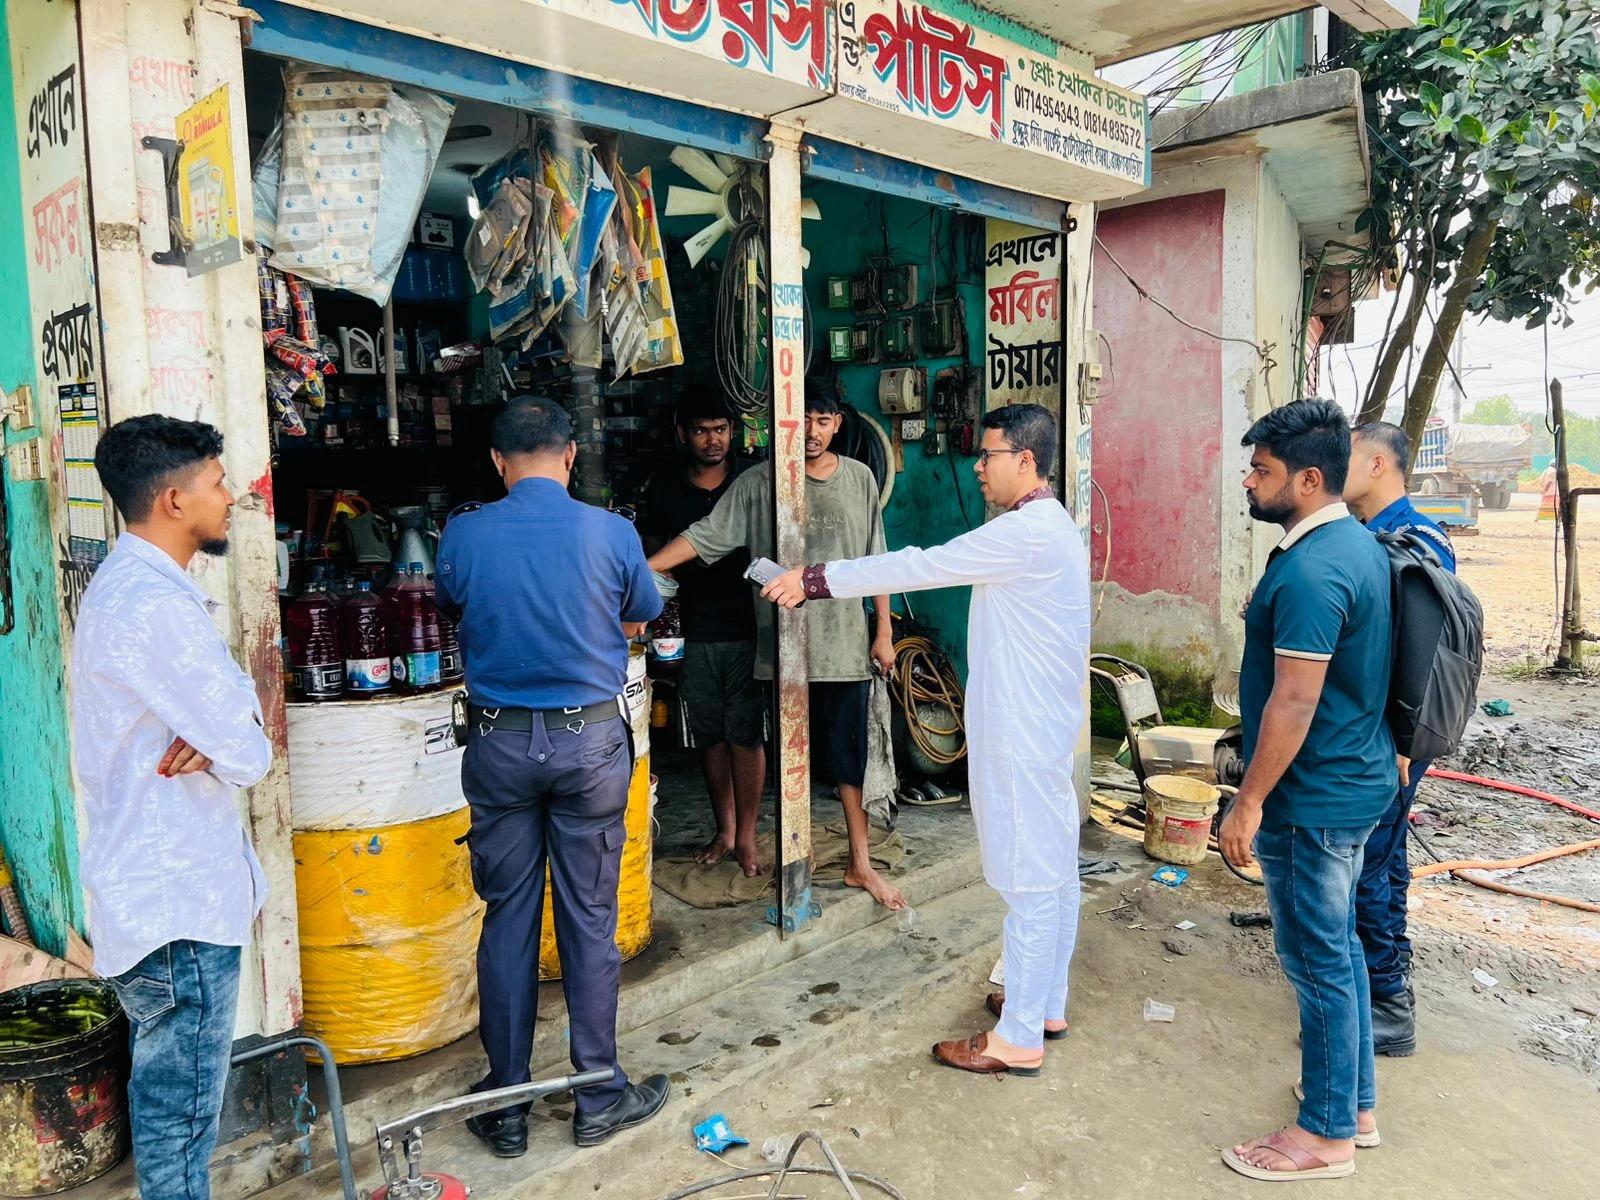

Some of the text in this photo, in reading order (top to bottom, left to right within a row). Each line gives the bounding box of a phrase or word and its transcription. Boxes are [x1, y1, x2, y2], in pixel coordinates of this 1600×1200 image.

[27, 63, 76, 159] এখানে
[1057, 70, 1103, 107] খোকন
[194, 110, 223, 141] RIMULA
[986, 232, 1060, 267] এখানে
[772, 283, 803, 309] খোকন
[988, 270, 1060, 325] মবিল
[42, 302, 94, 381] প্রকার
[987, 333, 1062, 390] টায়ার
